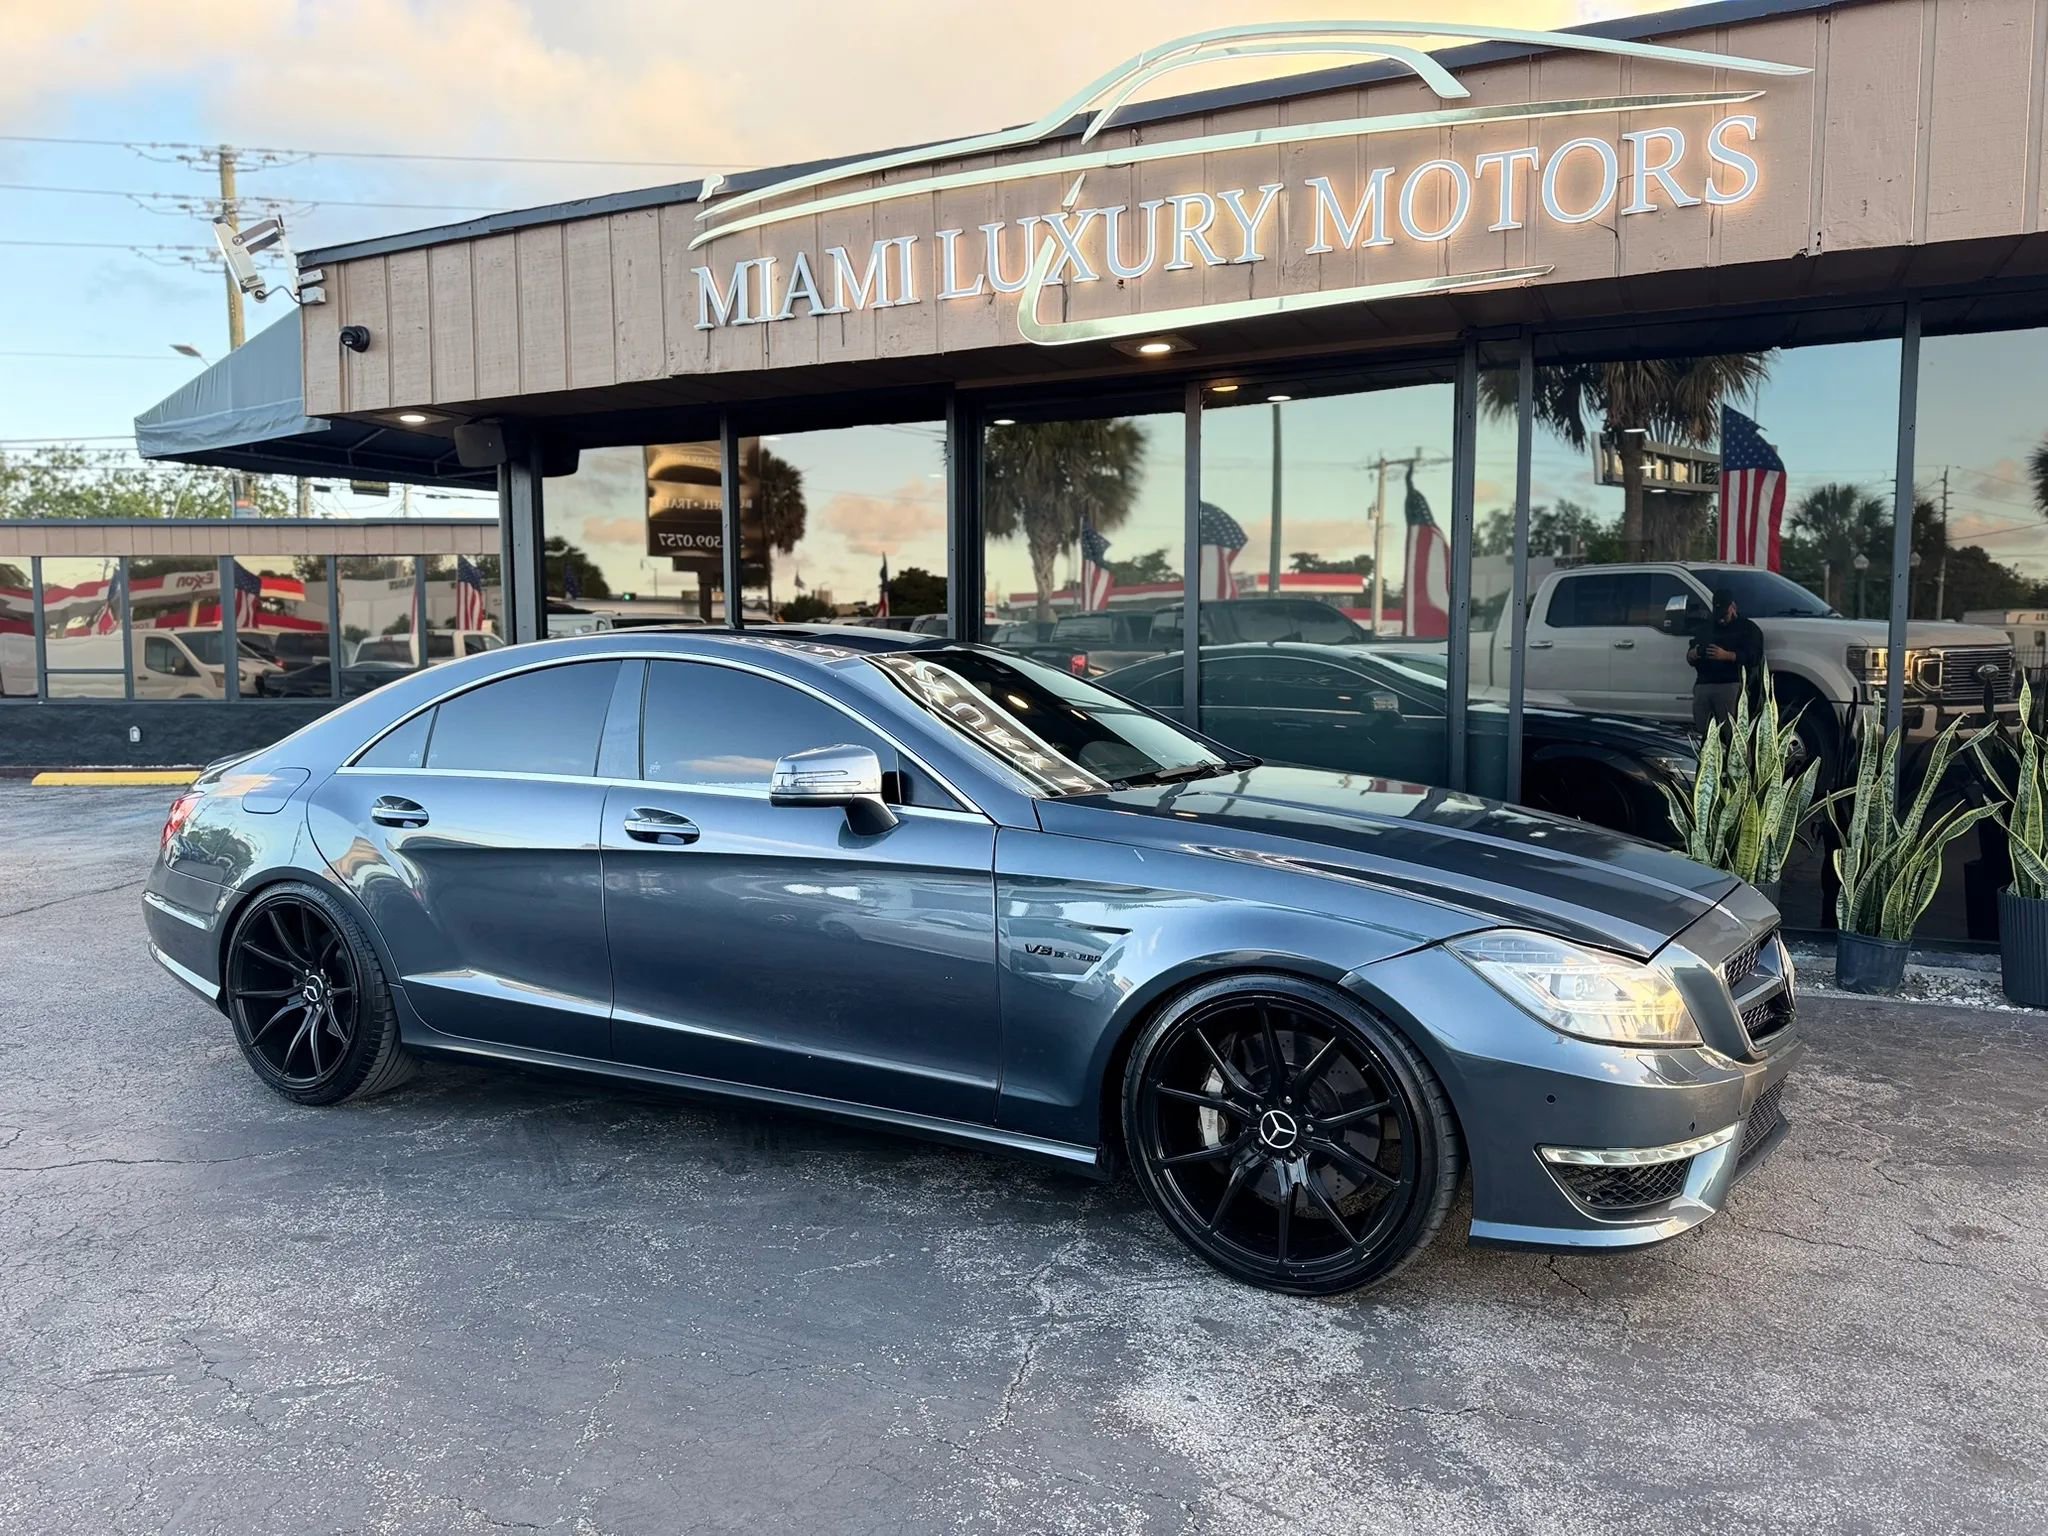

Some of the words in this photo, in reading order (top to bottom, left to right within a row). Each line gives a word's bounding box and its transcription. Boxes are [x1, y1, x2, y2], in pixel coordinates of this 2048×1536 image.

[691, 235, 920, 331] MIAMI
[936, 183, 1284, 302] LUXURY
[1305, 115, 1759, 255] MOTORS
[1025, 943, 1053, 956] V8
